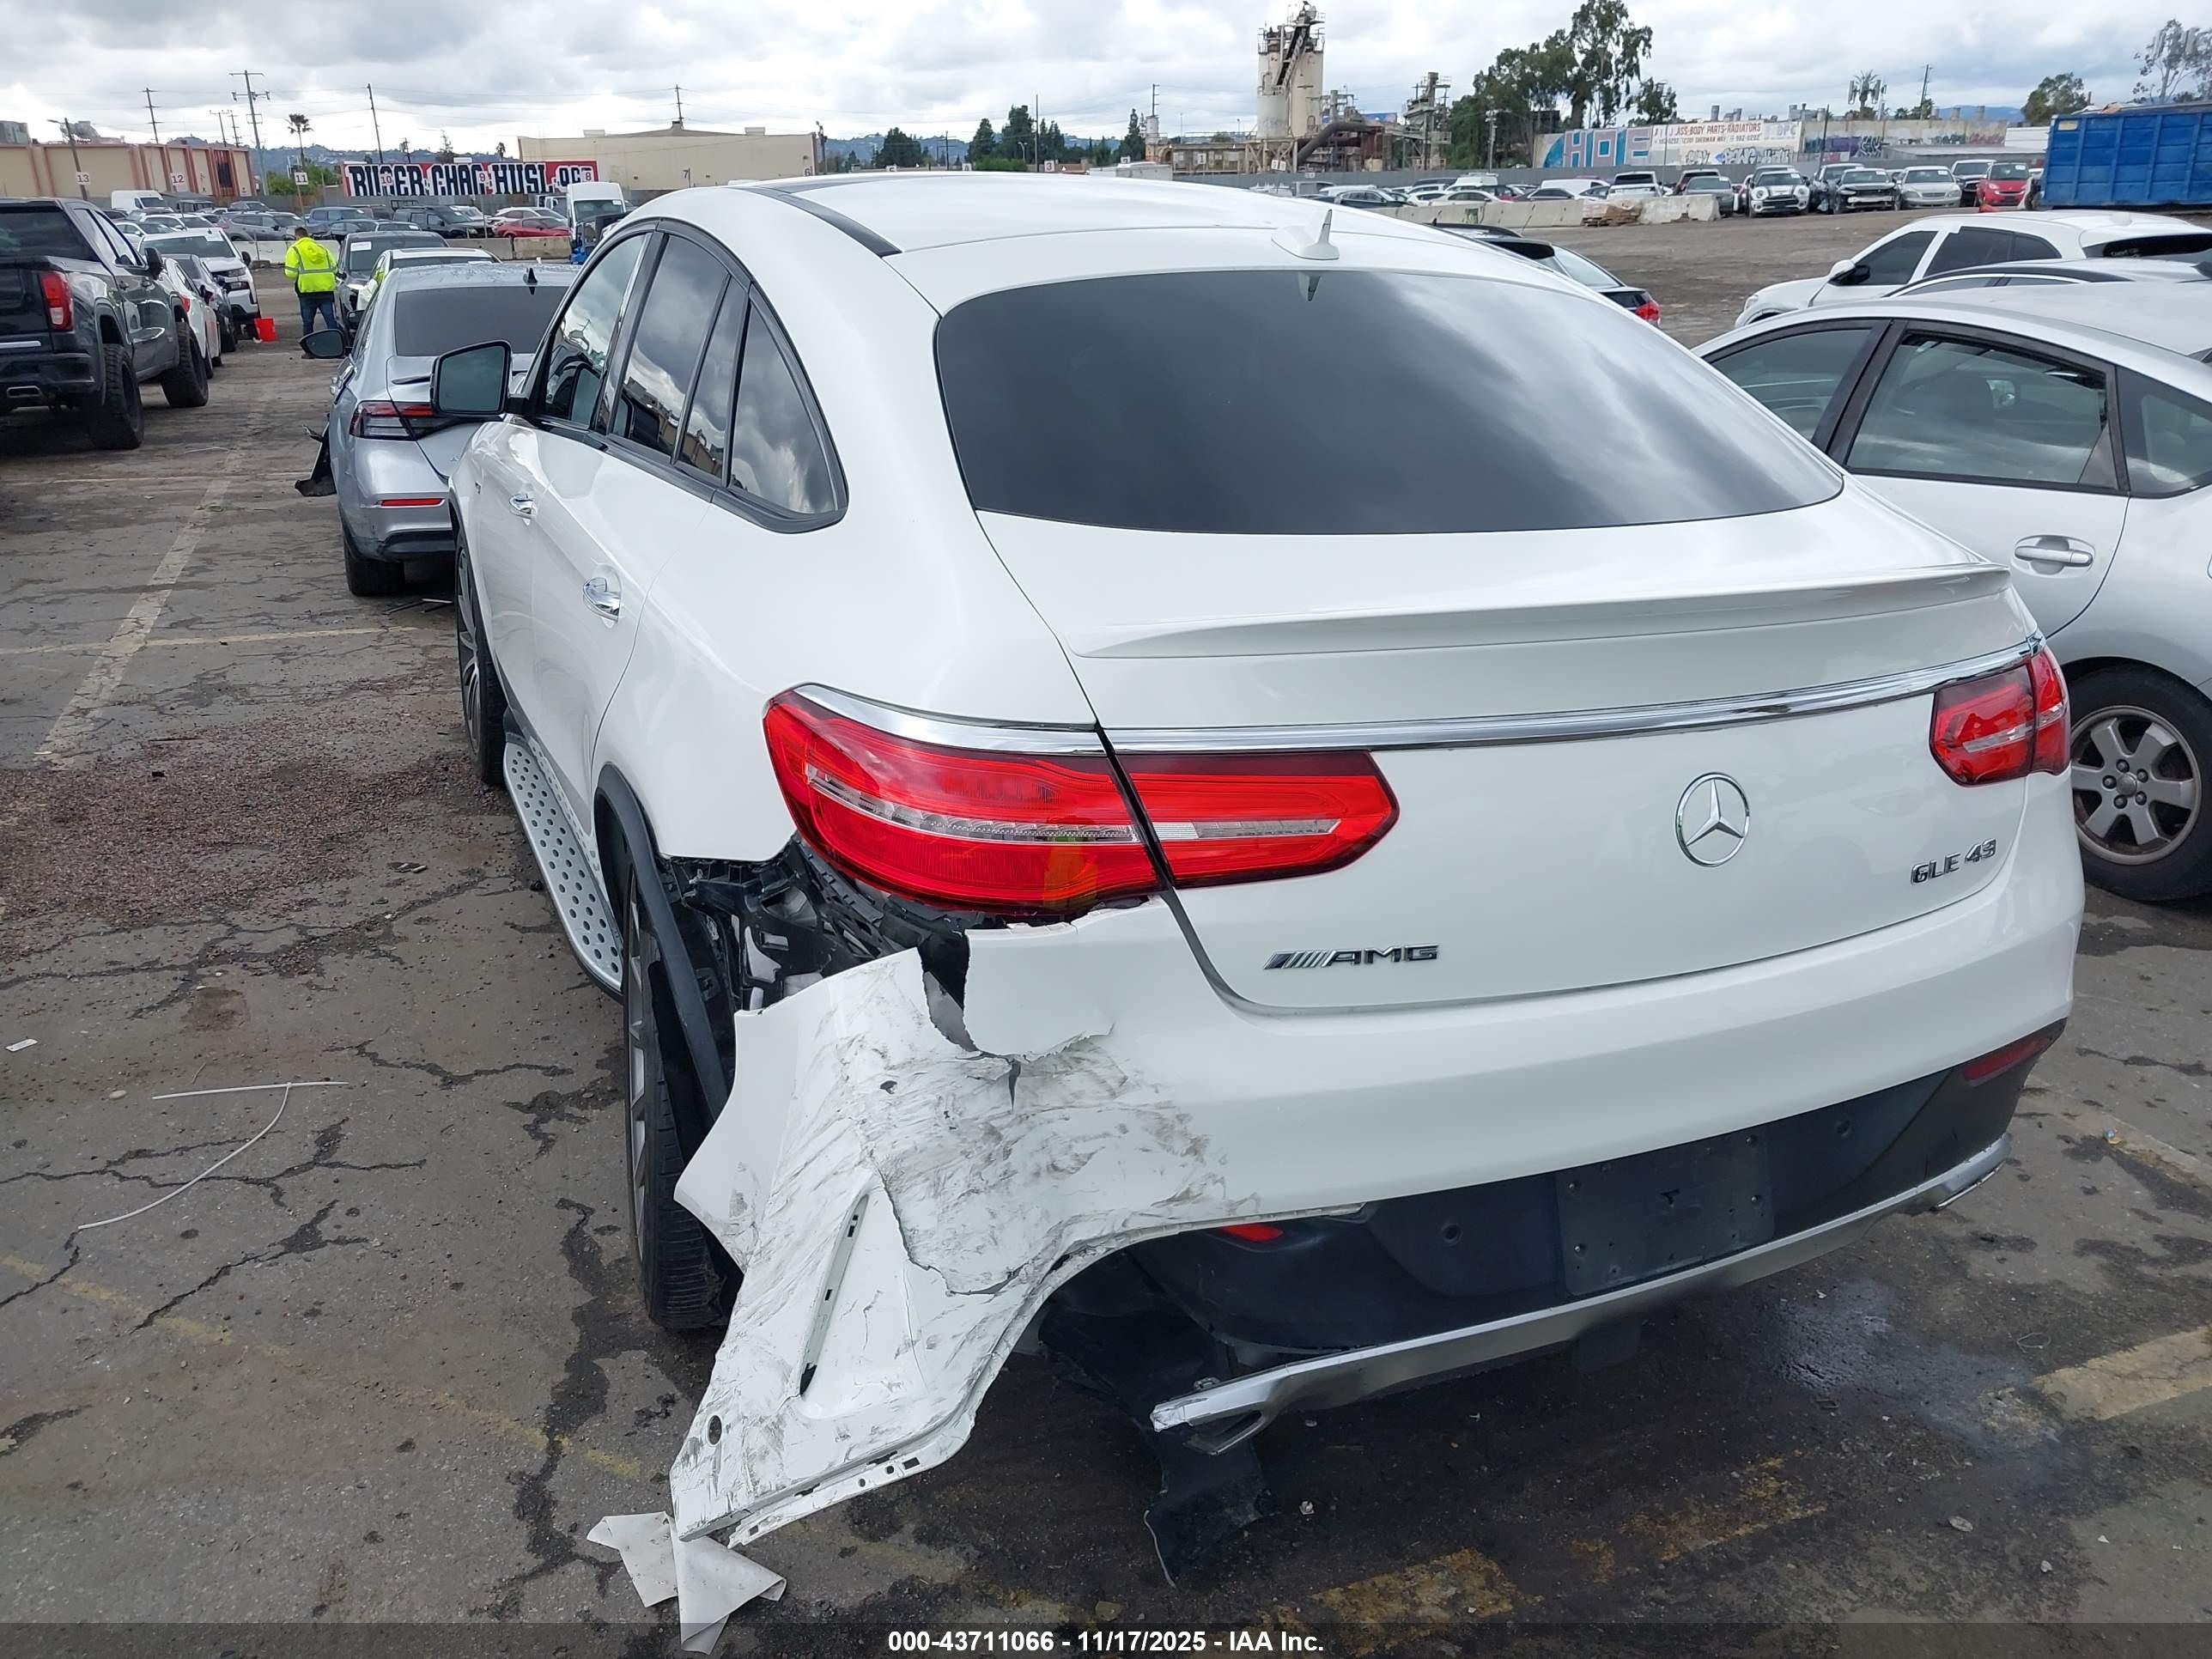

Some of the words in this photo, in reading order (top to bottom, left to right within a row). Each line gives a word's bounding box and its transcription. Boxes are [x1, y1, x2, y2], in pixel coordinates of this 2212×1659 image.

[77, 174, 90, 183] 13
[171, 174, 185, 184] 12
[295, 174, 307, 183] 11
[380, 175, 392, 185] 10
[558, 167, 592, 187] OC
[585, 172, 592, 181] 8
[1911, 852, 1961, 885] GLE
[1964, 837, 1997, 863] 43
[1322, 943, 1439, 968] AMG
